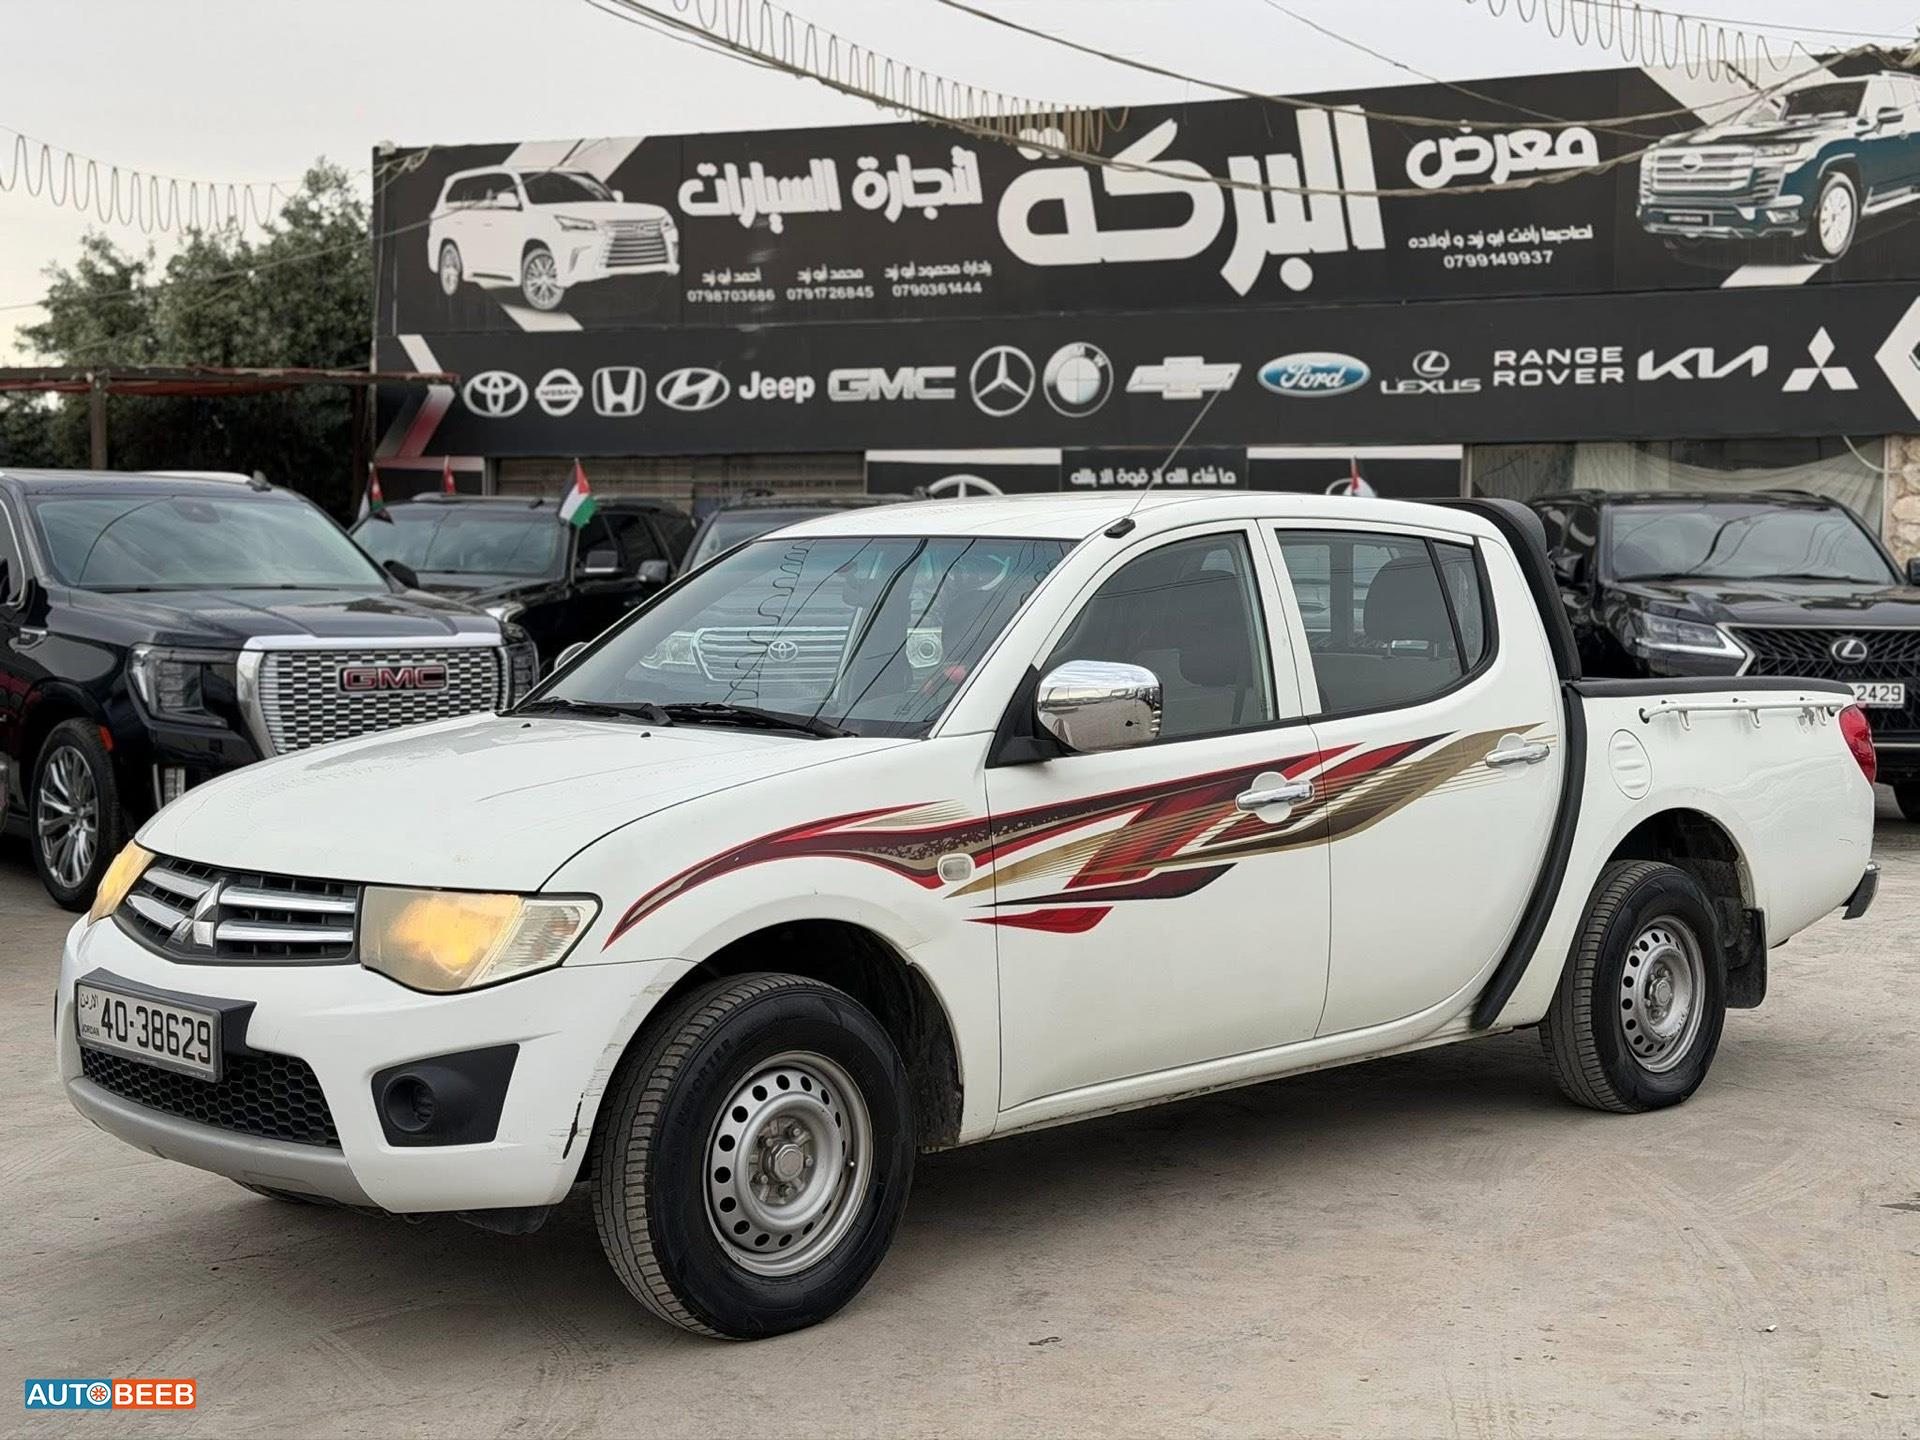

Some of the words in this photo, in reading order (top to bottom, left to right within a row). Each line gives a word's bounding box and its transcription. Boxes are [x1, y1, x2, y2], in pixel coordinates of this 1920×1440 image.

[1406, 119, 1600, 189] معرض
[852, 146, 983, 223] لتجارة
[678, 158, 842, 234] السيارات
[997, 104, 1386, 297] البركة
[1452, 234, 1465, 249] و
[1466, 230, 1485, 249] زيد
[1443, 249, 1553, 269] 0799149937
[829, 268, 864, 280] محمد
[917, 263, 961, 279] محمود
[1493, 346, 1623, 367] RANGE
[827, 366, 957, 402] GMC
[1279, 363, 1345, 390] Ford
[1380, 377, 1482, 395] LEXUS
[1493, 367, 1624, 387] ROVER
[738, 370, 816, 404] Jeep
[1070, 468, 1097, 487] بالله
[1116, 468, 1149, 487] قوة
[1165, 468, 1189, 484] الله
[1191, 465, 1217, 484] شاء
[1218, 467, 1237, 484] ما
[343, 667, 444, 690] GMC
[1856, 684, 1902, 702] 2429
[82, 1023, 99, 1036] JORDAN
[101, 997, 211, 1065] 40-38629
